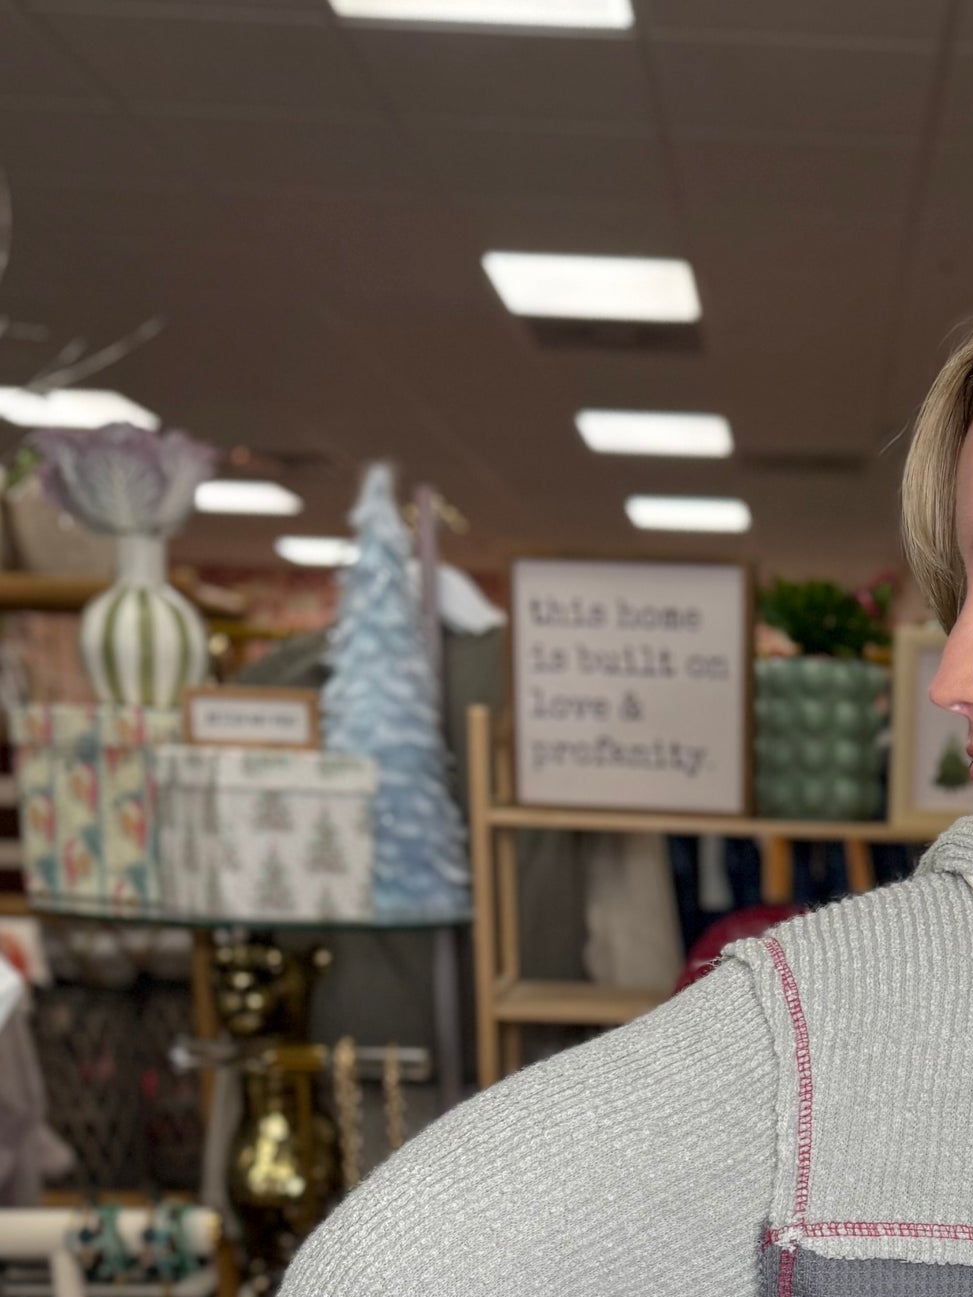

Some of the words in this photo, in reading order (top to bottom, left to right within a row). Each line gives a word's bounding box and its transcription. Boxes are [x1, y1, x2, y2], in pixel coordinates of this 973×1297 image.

[530, 597, 605, 628] this
[616, 597, 705, 632] home
[532, 642, 567, 674] is
[575, 643, 676, 679] built
[684, 653, 729, 680] on
[531, 688, 608, 721] love
[618, 689, 645, 723] &
